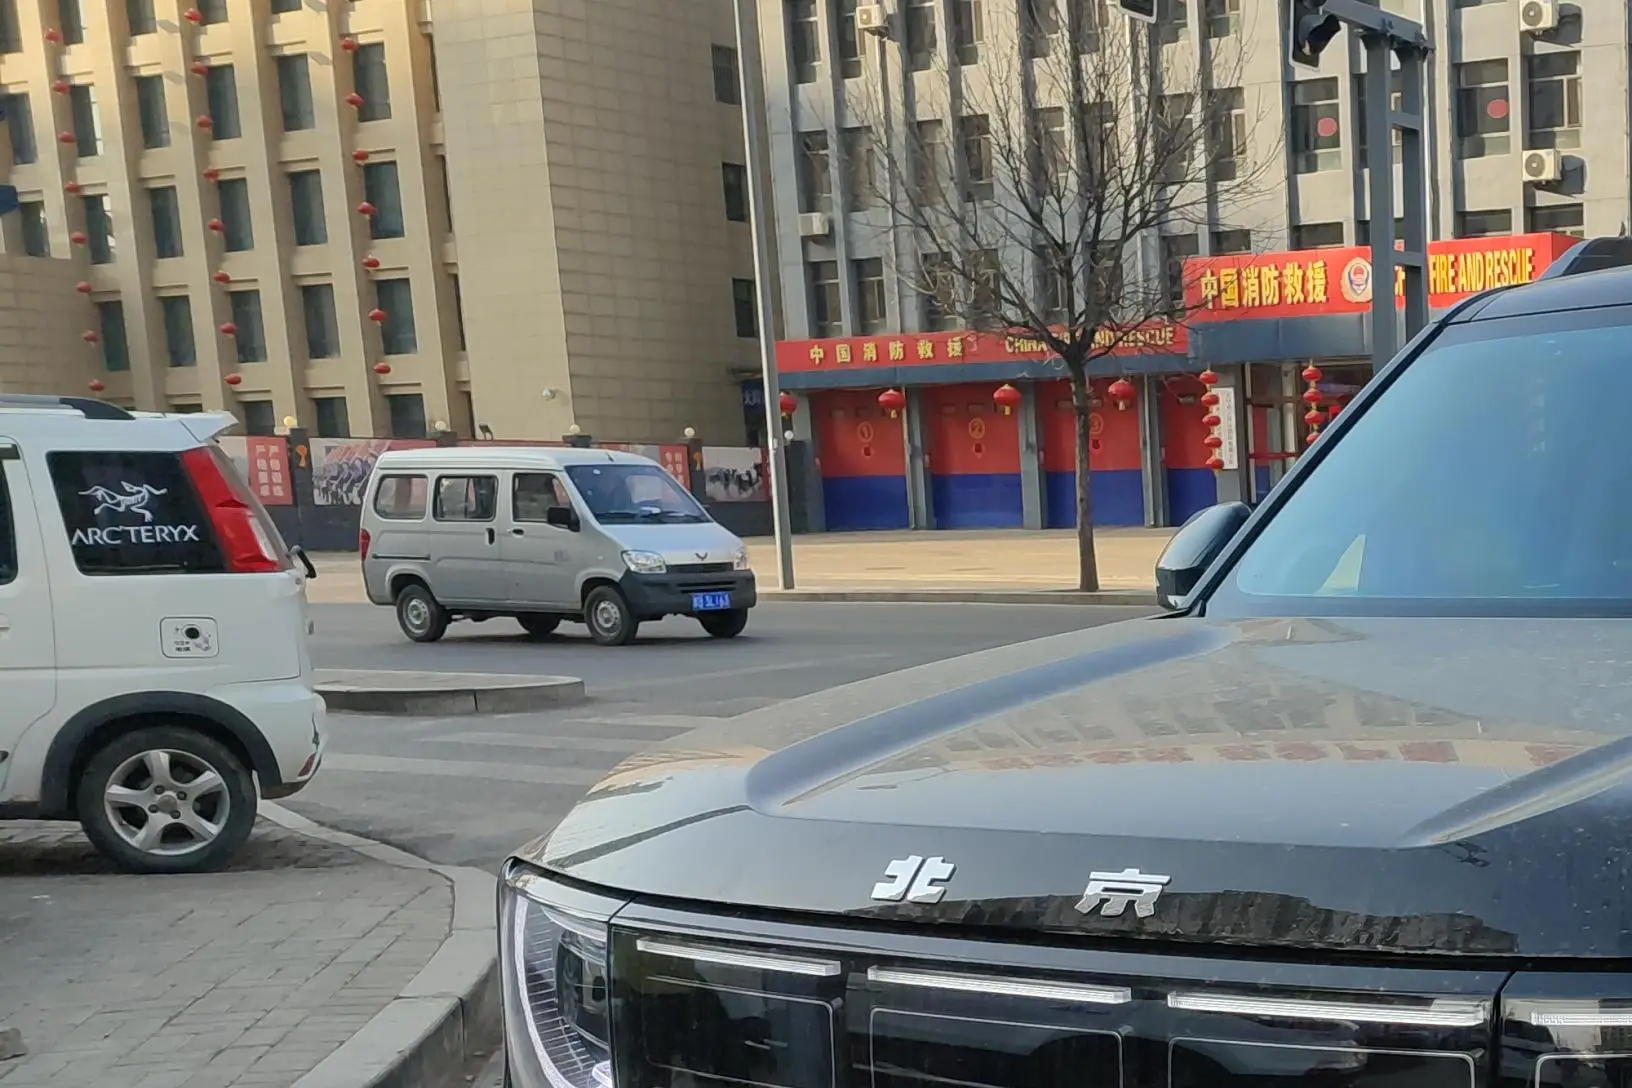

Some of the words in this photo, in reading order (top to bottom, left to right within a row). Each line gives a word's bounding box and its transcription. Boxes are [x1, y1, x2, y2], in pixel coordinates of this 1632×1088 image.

[1201, 259, 1328, 310] 中国消防救援
[1430, 254, 1456, 294] FIRE
[1458, 251, 1486, 293] AND
[1487, 247, 1534, 290] RESCUE
[809, 336, 964, 365] 中国消防救援
[1005, 335, 1048, 354] CHINA
